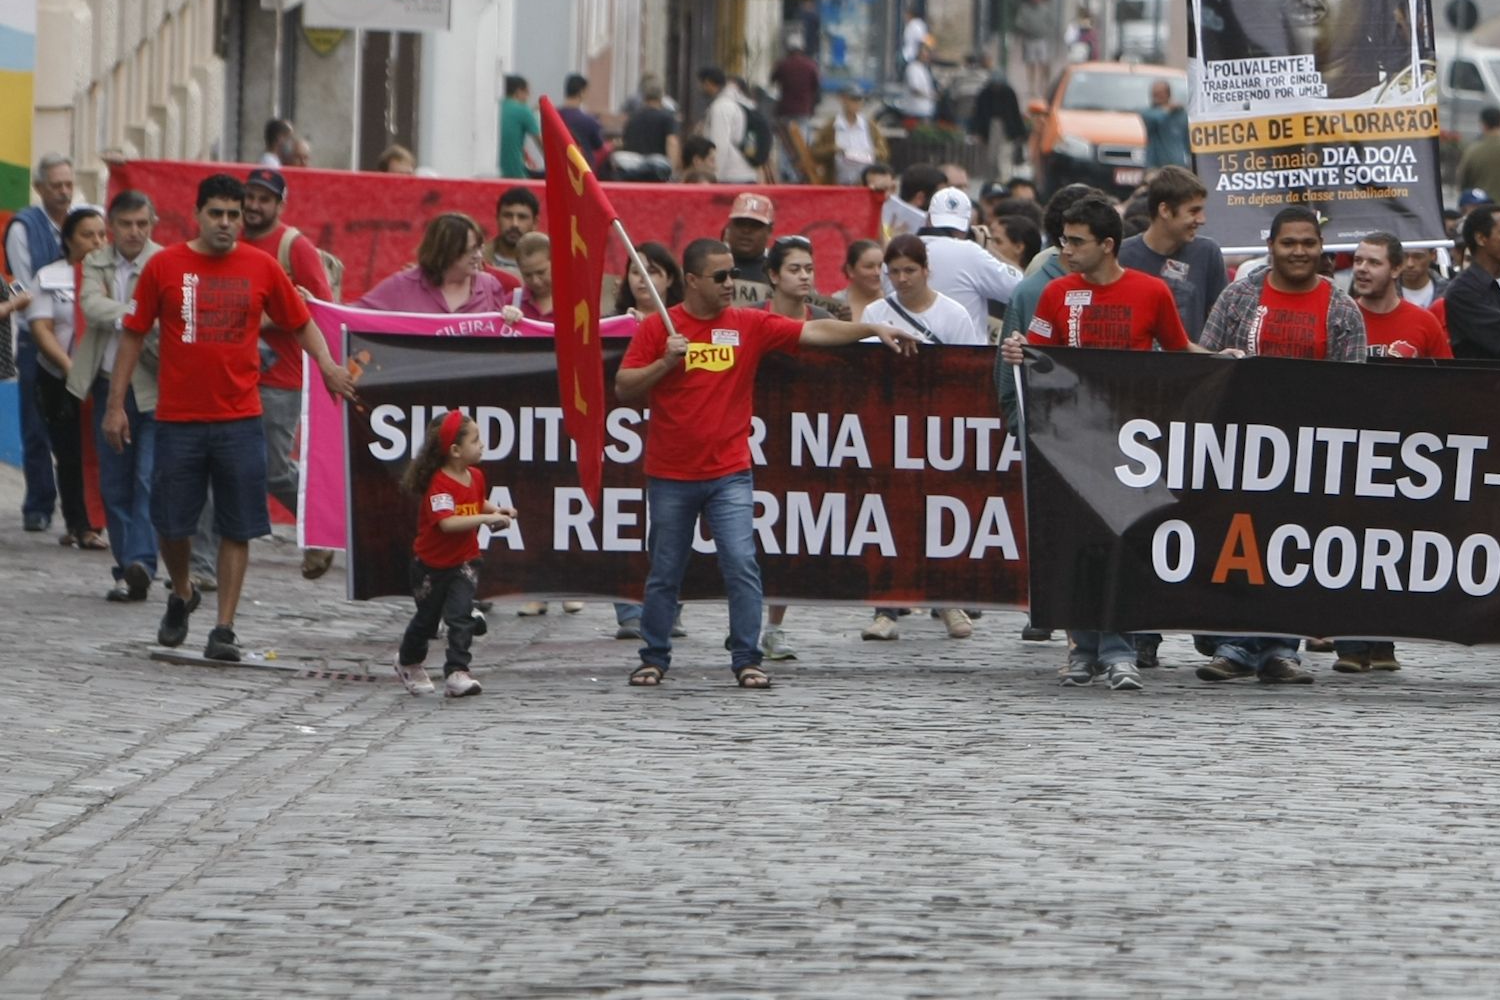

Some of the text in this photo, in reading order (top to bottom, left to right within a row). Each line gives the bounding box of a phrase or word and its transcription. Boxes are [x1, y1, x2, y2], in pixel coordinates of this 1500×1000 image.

[1202, 72, 1320, 92] TRABALHAR POR CINCO
[1212, 84, 1327, 103] RECEBENDO POR UMA?
[1191, 108, 1440, 147] CHEGA DE EXPLORAÇÃO!
[1216, 143, 1418, 172] 15 de maio DIA DO/A
[1215, 164, 1419, 192] ASSISTENTE SOCIAL
[1227, 187, 1409, 208] Em defesa da classe trabalhadora
[688, 347, 731, 365] PSTU
[790, 411, 872, 469] NA
[924, 493, 1021, 561] DA
[1151, 518, 1197, 584] O
